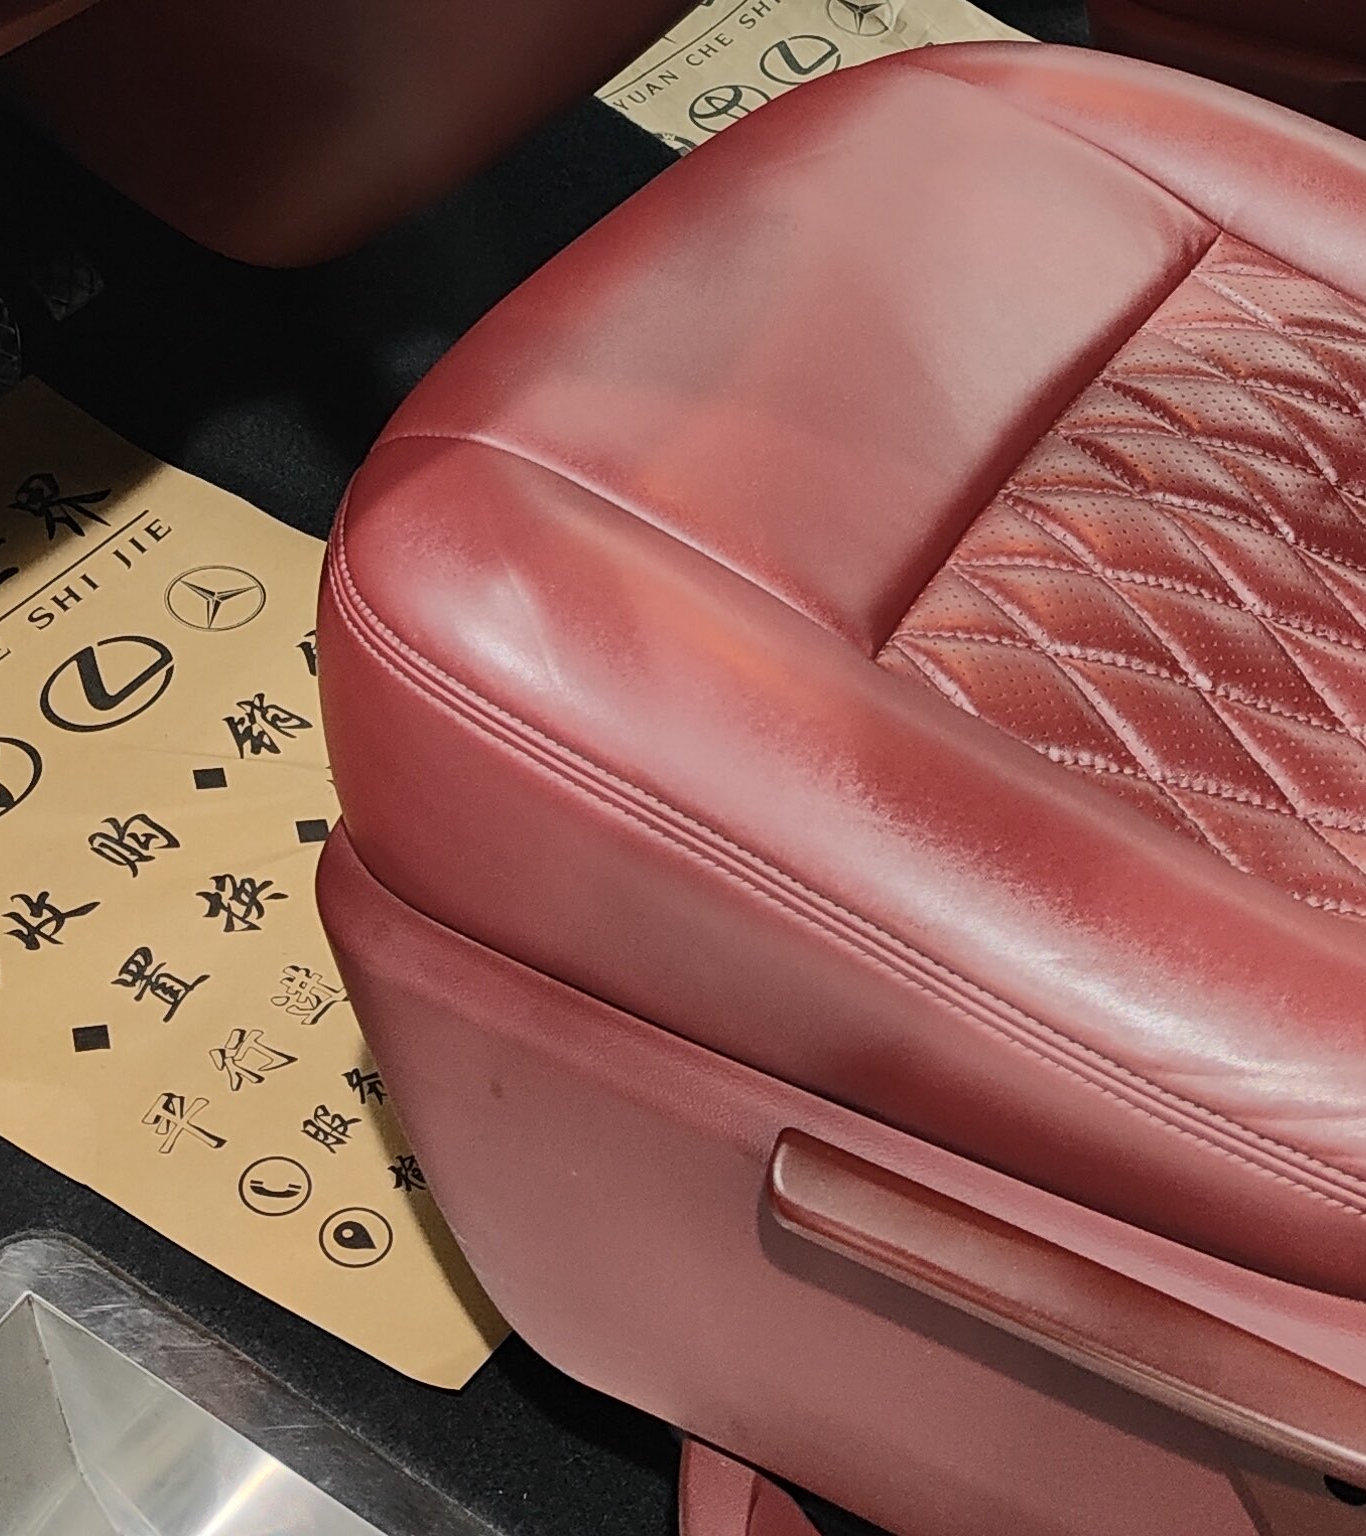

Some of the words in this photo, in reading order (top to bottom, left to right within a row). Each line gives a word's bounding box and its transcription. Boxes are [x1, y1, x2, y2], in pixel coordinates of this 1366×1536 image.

[612, 69, 680, 112] YUAN
[685, 32, 734, 68] CHE
[28, 574, 100, 630] SHI
[112, 518, 172, 569] JIE
